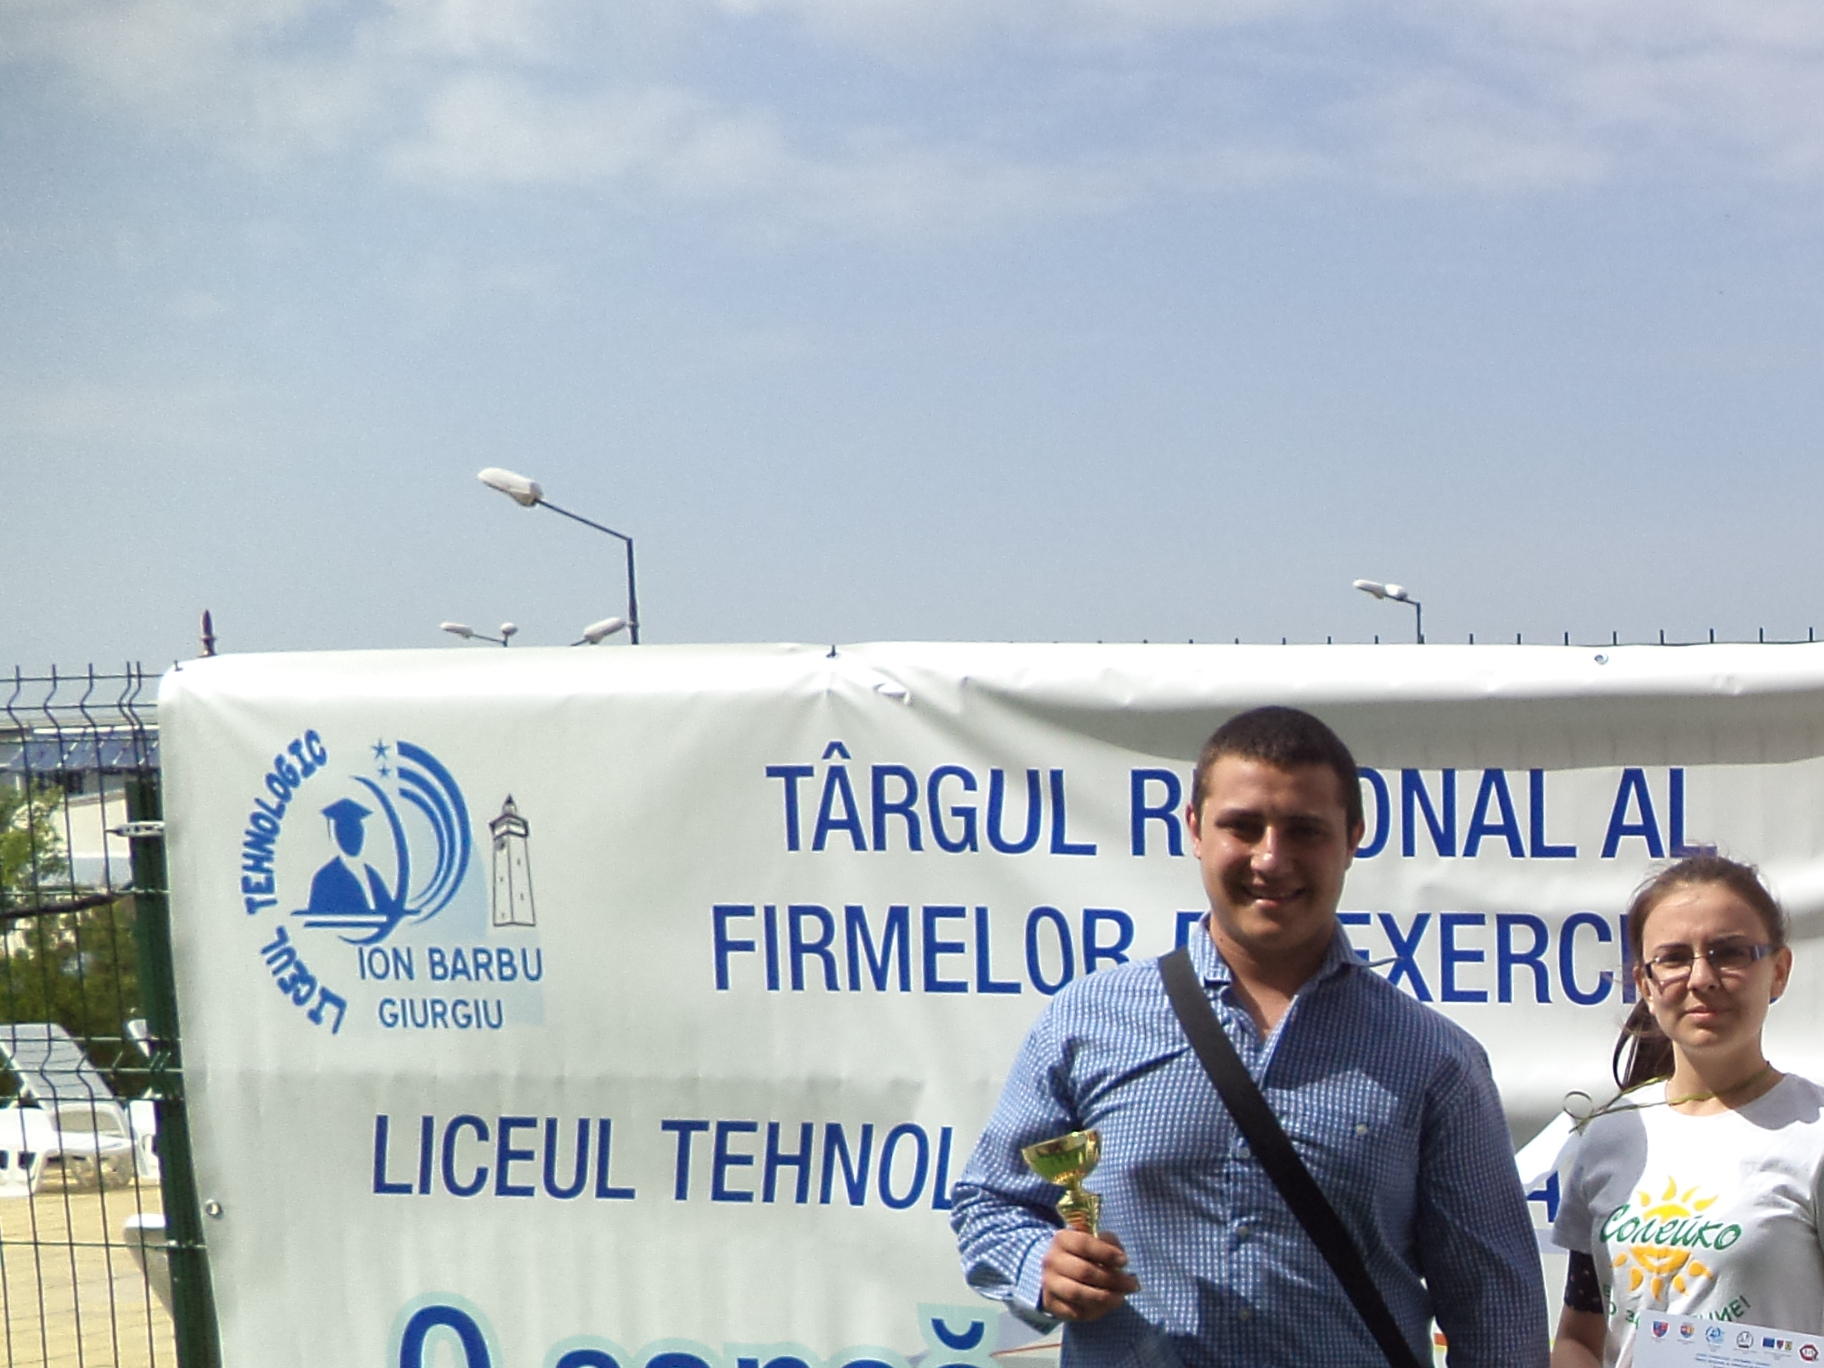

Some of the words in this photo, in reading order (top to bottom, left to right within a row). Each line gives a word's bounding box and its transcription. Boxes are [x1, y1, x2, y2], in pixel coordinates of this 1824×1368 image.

[242, 729, 327, 914] TEHNOLOGIC
[765, 741, 1097, 856] TÂRGUL
[1131, 767, 1577, 858] RONAL
[1600, 767, 1717, 858] AL
[261, 926, 347, 1034] LICEUL
[357, 946, 414, 980] ION
[428, 947, 543, 981] BARBU
[712, 904, 1135, 997] FIRMELOR
[378, 998, 503, 1029] GIURGIU
[373, 1114, 636, 1200] LICEUL
[661, 1119, 954, 1211] TEHNOL
[1600, 1204, 1742, 1250] Солейко
